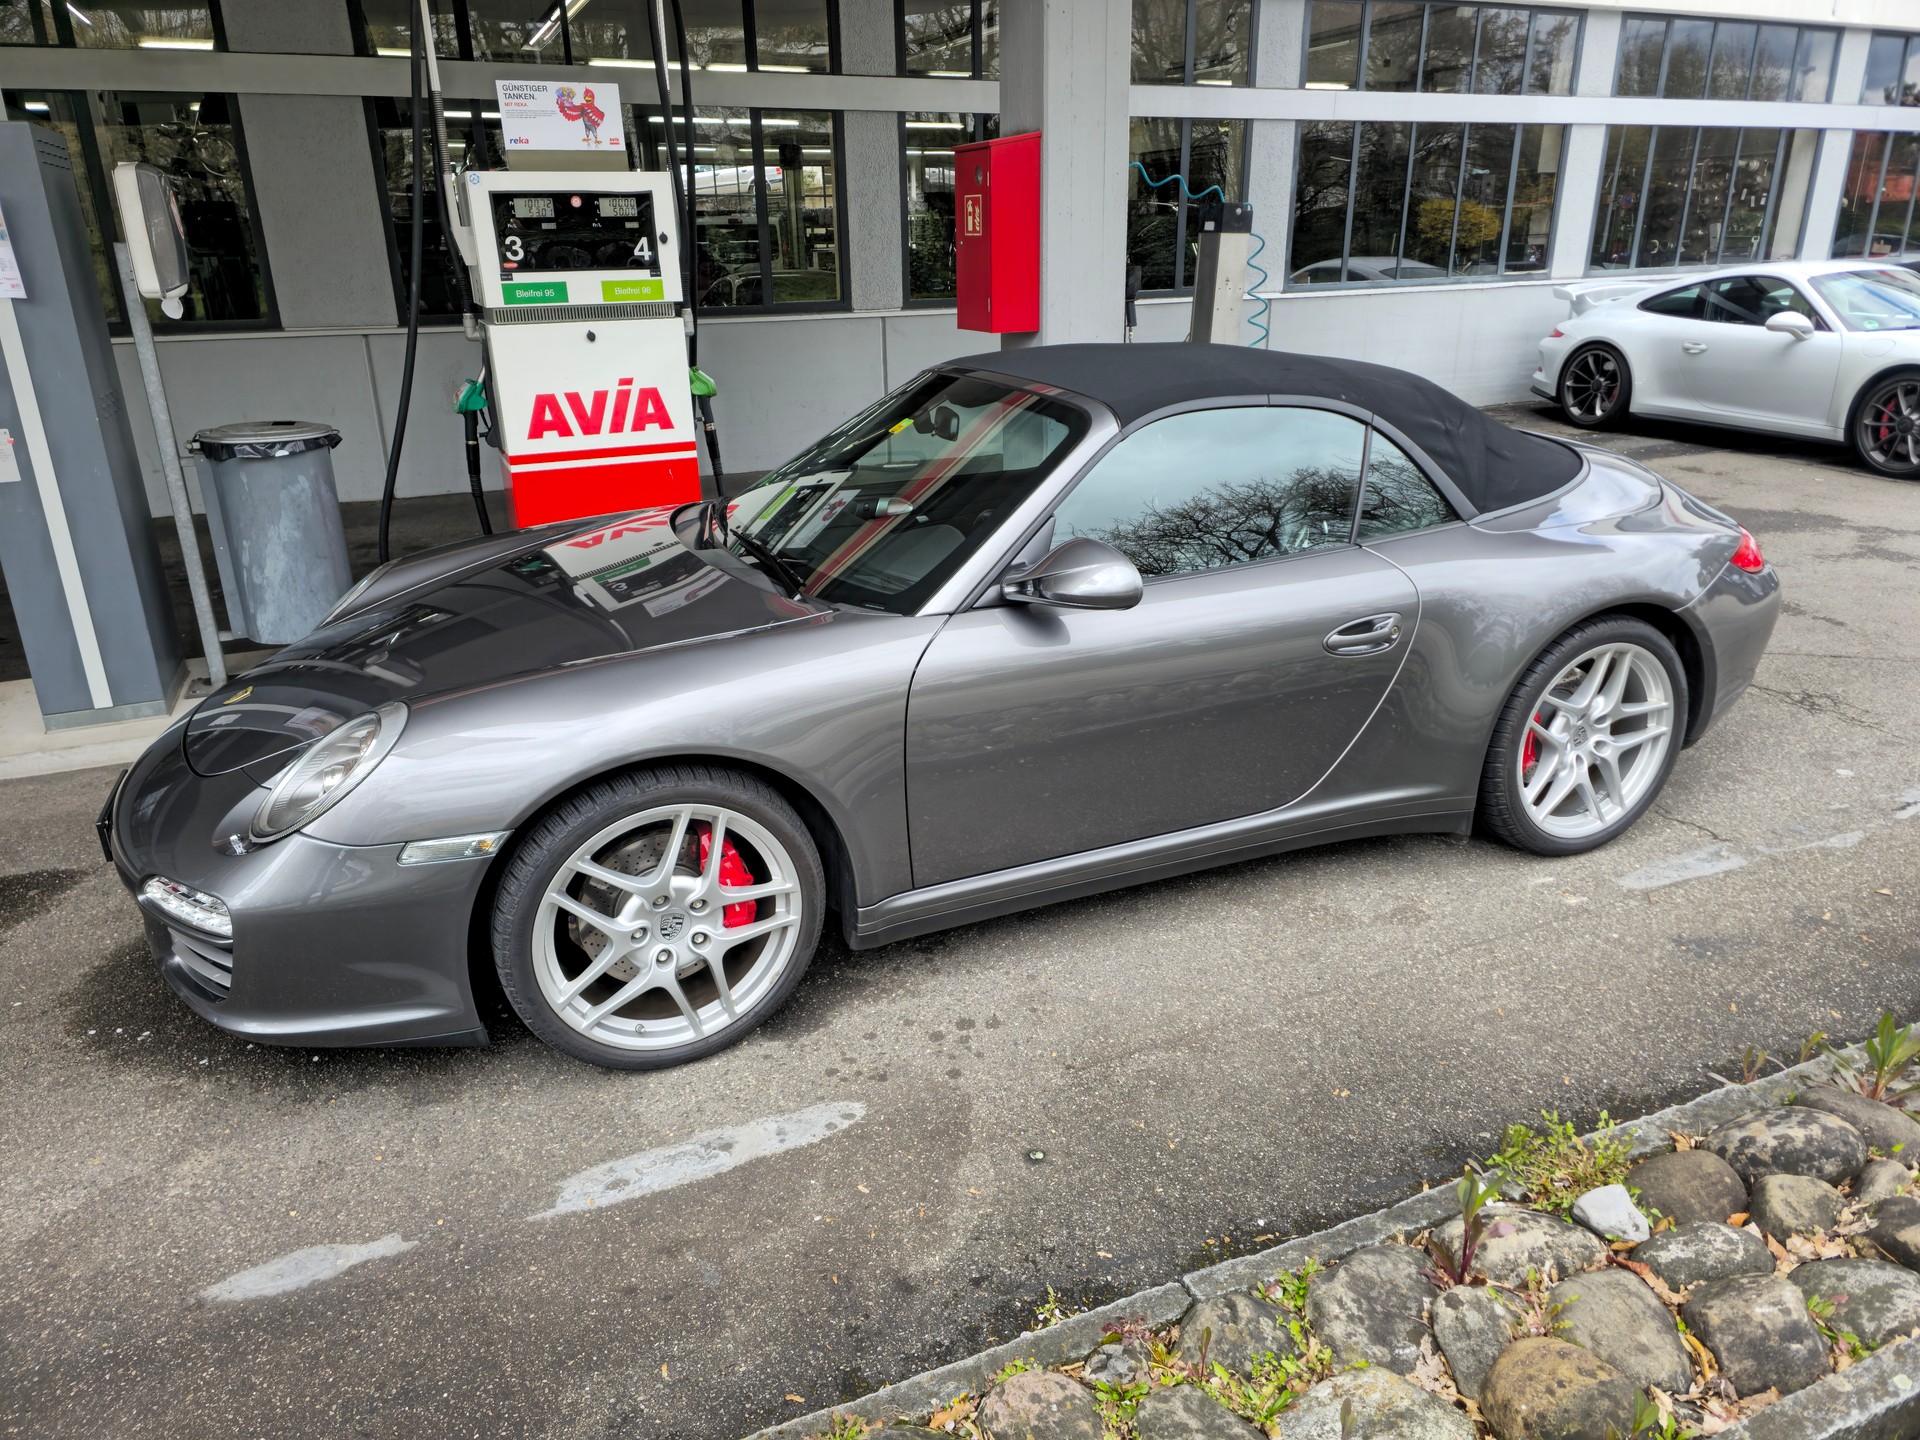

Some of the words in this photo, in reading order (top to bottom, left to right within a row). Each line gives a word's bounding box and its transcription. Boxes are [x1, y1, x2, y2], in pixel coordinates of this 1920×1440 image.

[502, 82, 548, 92] GÜNSTIGER
[503, 92, 537, 100] TANKEN.
[509, 136, 529, 144] reka
[504, 235, 525, 261] 3
[633, 236, 652, 261] 4
[515, 289, 543, 298] Bleifrei
[544, 288, 555, 297] 95
[614, 286, 641, 295] Bleifrei
[641, 286, 652, 294] 98
